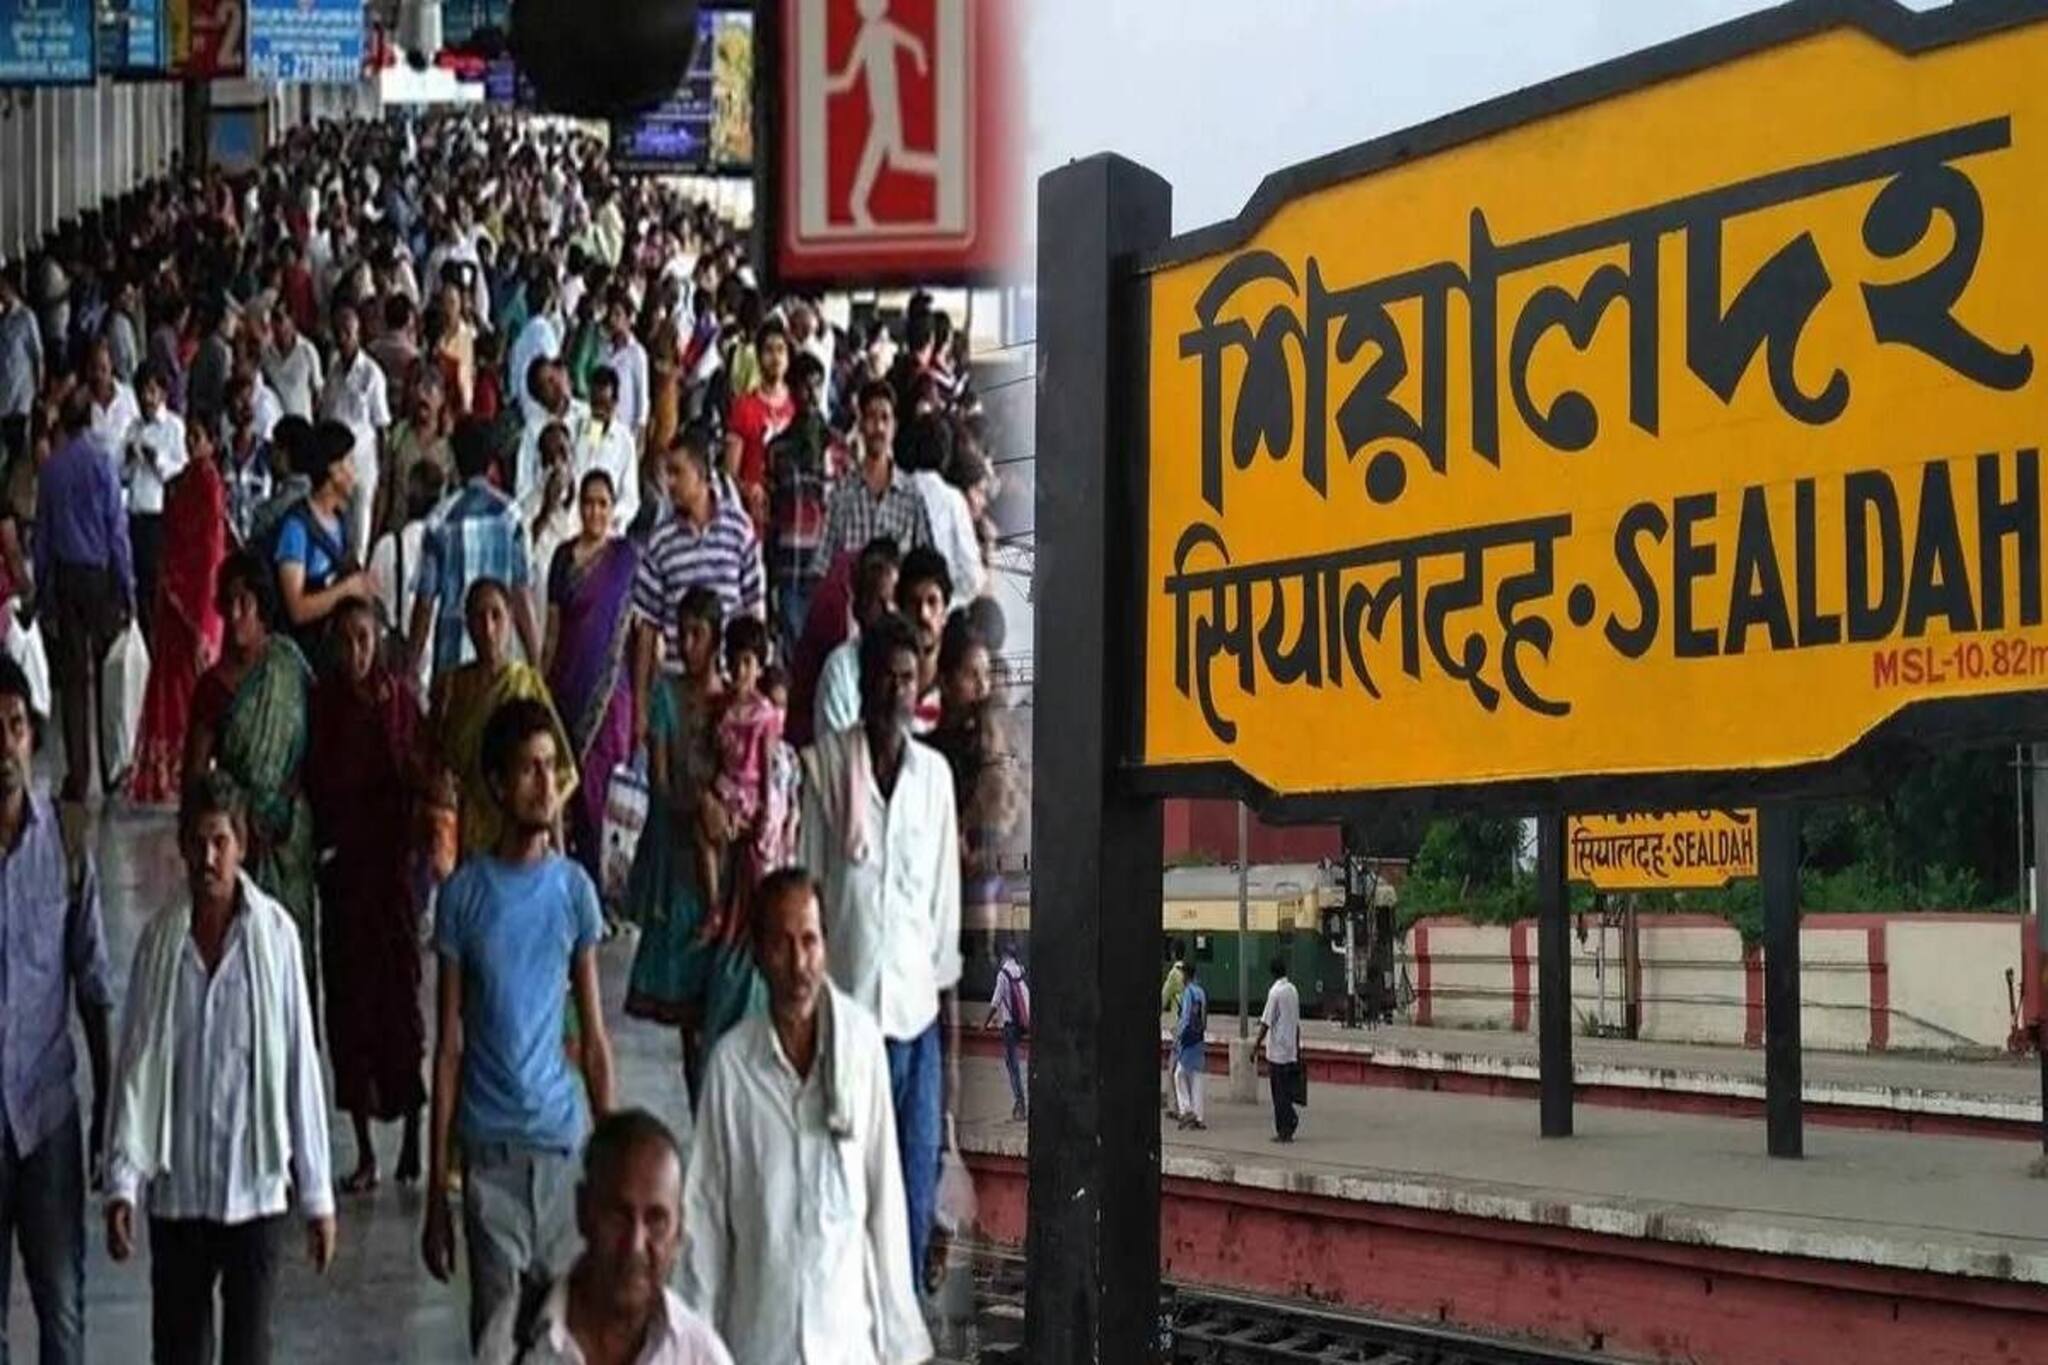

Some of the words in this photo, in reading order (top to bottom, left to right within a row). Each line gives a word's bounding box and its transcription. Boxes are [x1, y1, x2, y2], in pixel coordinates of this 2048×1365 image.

[1180, 116, 2033, 515] শিয়ালদহ
[1165, 515, 1571, 743] सियालदह
[1605, 449, 2042, 658] SEALDAH
[1571, 827, 1667, 877] सियालदह
[1673, 829, 1753, 867] SEALDAH
